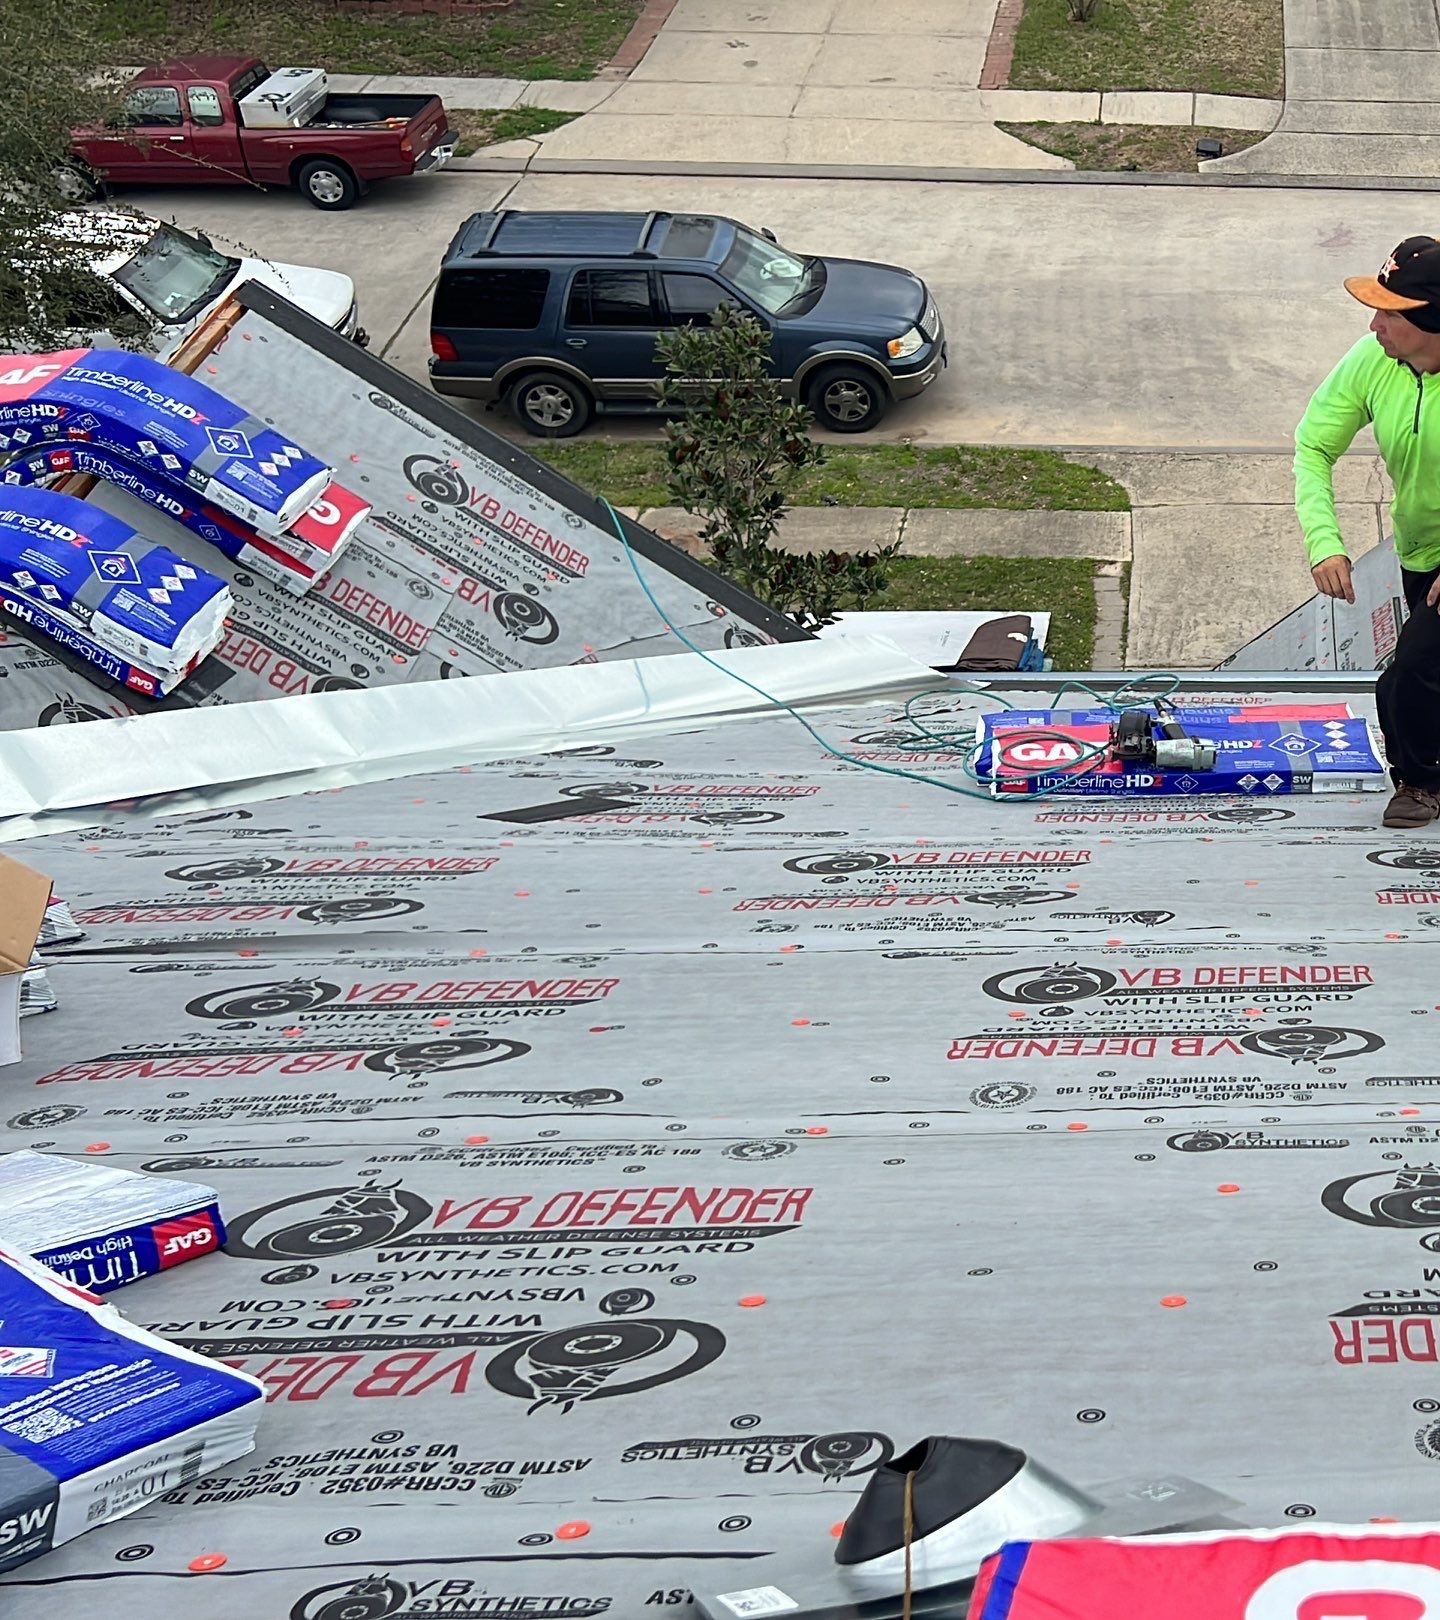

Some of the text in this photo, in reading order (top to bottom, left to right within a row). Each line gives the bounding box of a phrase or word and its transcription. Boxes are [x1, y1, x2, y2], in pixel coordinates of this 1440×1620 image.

[69, 366, 208, 425] Timberline HDZ
[51, 451, 156, 499] GAF Timberline
[38, 518, 92, 548] HDZ
[469, 486, 590, 577] VB DEFENDER
[492, 535, 520, 556] SLIP
[457, 577, 491, 613] VB
[71, 601, 93, 618] SW
[31, 613, 155, 691] GAF Timberline
[14, 660, 38, 671] ASTM
[268, 660, 312, 695] VB
[1223, 739, 1263, 750] HDZ
[651, 784, 822, 796] VB DEFENDER
[1126, 775, 1162, 788] HDZ
[1291, 775, 1312, 786] SW
[1033, 812, 1210, 824] VB DEFENDER
[284, 857, 502, 872] VB DEFENDER
[892, 850, 1092, 864] VB DEFENDER
[857, 875, 1037, 884] VBSYNTHETICS.COM
[733, 896, 900, 912] DEFENDER
[905, 896, 961, 906] VB
[1117, 965, 1375, 987] VB DEFENDER
[345, 978, 621, 1002] VB DEFENDER
[1103, 993, 1353, 1006] WITH SLIP GUARD
[299, 1008, 567, 1022] WITH SLIP GUARD
[946, 1038, 1245, 1060] VB DEFENDER
[37, 1052, 367, 1085] VB DEFENDER
[1056, 1082, 1348, 1095] ASTM ASTM 188
[1227, 1131, 1350, 1148] VB SYNTHETICS
[1369, 1135, 1414, 1144] ASTM
[485, 1158, 596, 1167] SYNTHETICS
[432, 1186, 814, 1230] VB DEFENDER
[164, 1227, 213, 1257] GAF
[407, 1227, 761, 1245] ALL WEATHER DEFENSE SYSTEMS
[376, 1240, 756, 1263] WITH SLIP GUARD
[329, 1261, 680, 1285] VBSYNTHETICS.COM
[307, 1313, 543, 1331] WITH SLIP
[217, 1336, 457, 1353] WEATHER DEFENSE
[352, 1350, 478, 1398] VB
[264, 1443, 459, 1469] VB SYNTHETICS
[621, 1446, 801, 1474] VB SYNTHETICS
[367, 1458, 592, 1477] ASTM ASTM
[193, 1477, 478, 1505] CCRR#0352 Certified
[0, 1502, 55, 1545] SW
[402, 1578, 612, 1612] VB SYNTHETICS
